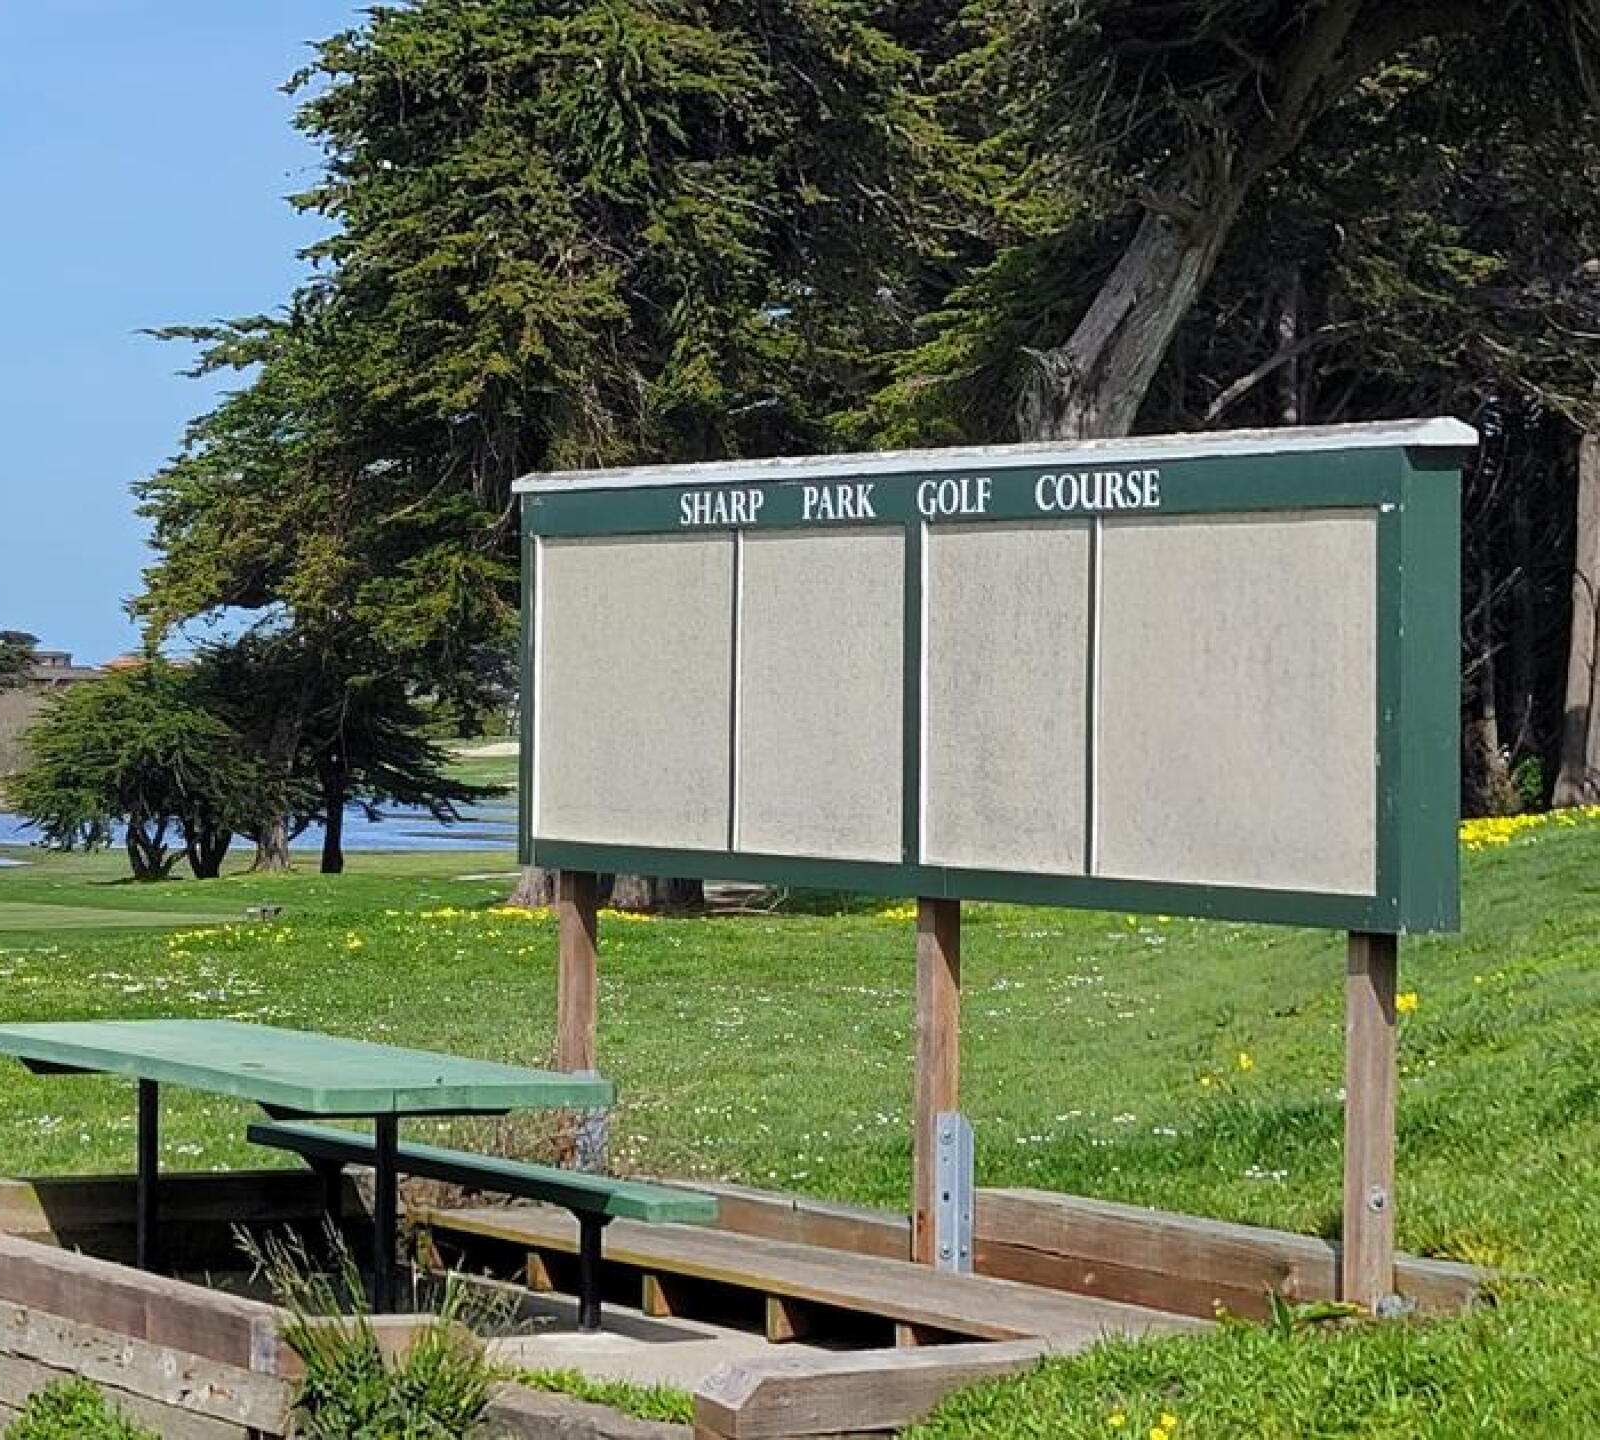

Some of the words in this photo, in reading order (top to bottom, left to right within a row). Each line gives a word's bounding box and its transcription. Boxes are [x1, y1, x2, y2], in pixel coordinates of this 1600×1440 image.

[680, 489, 763, 525] SHARP
[802, 486, 876, 520] PARK
[917, 478, 992, 516] GOLF
[1035, 470, 1160, 511] COURSE
